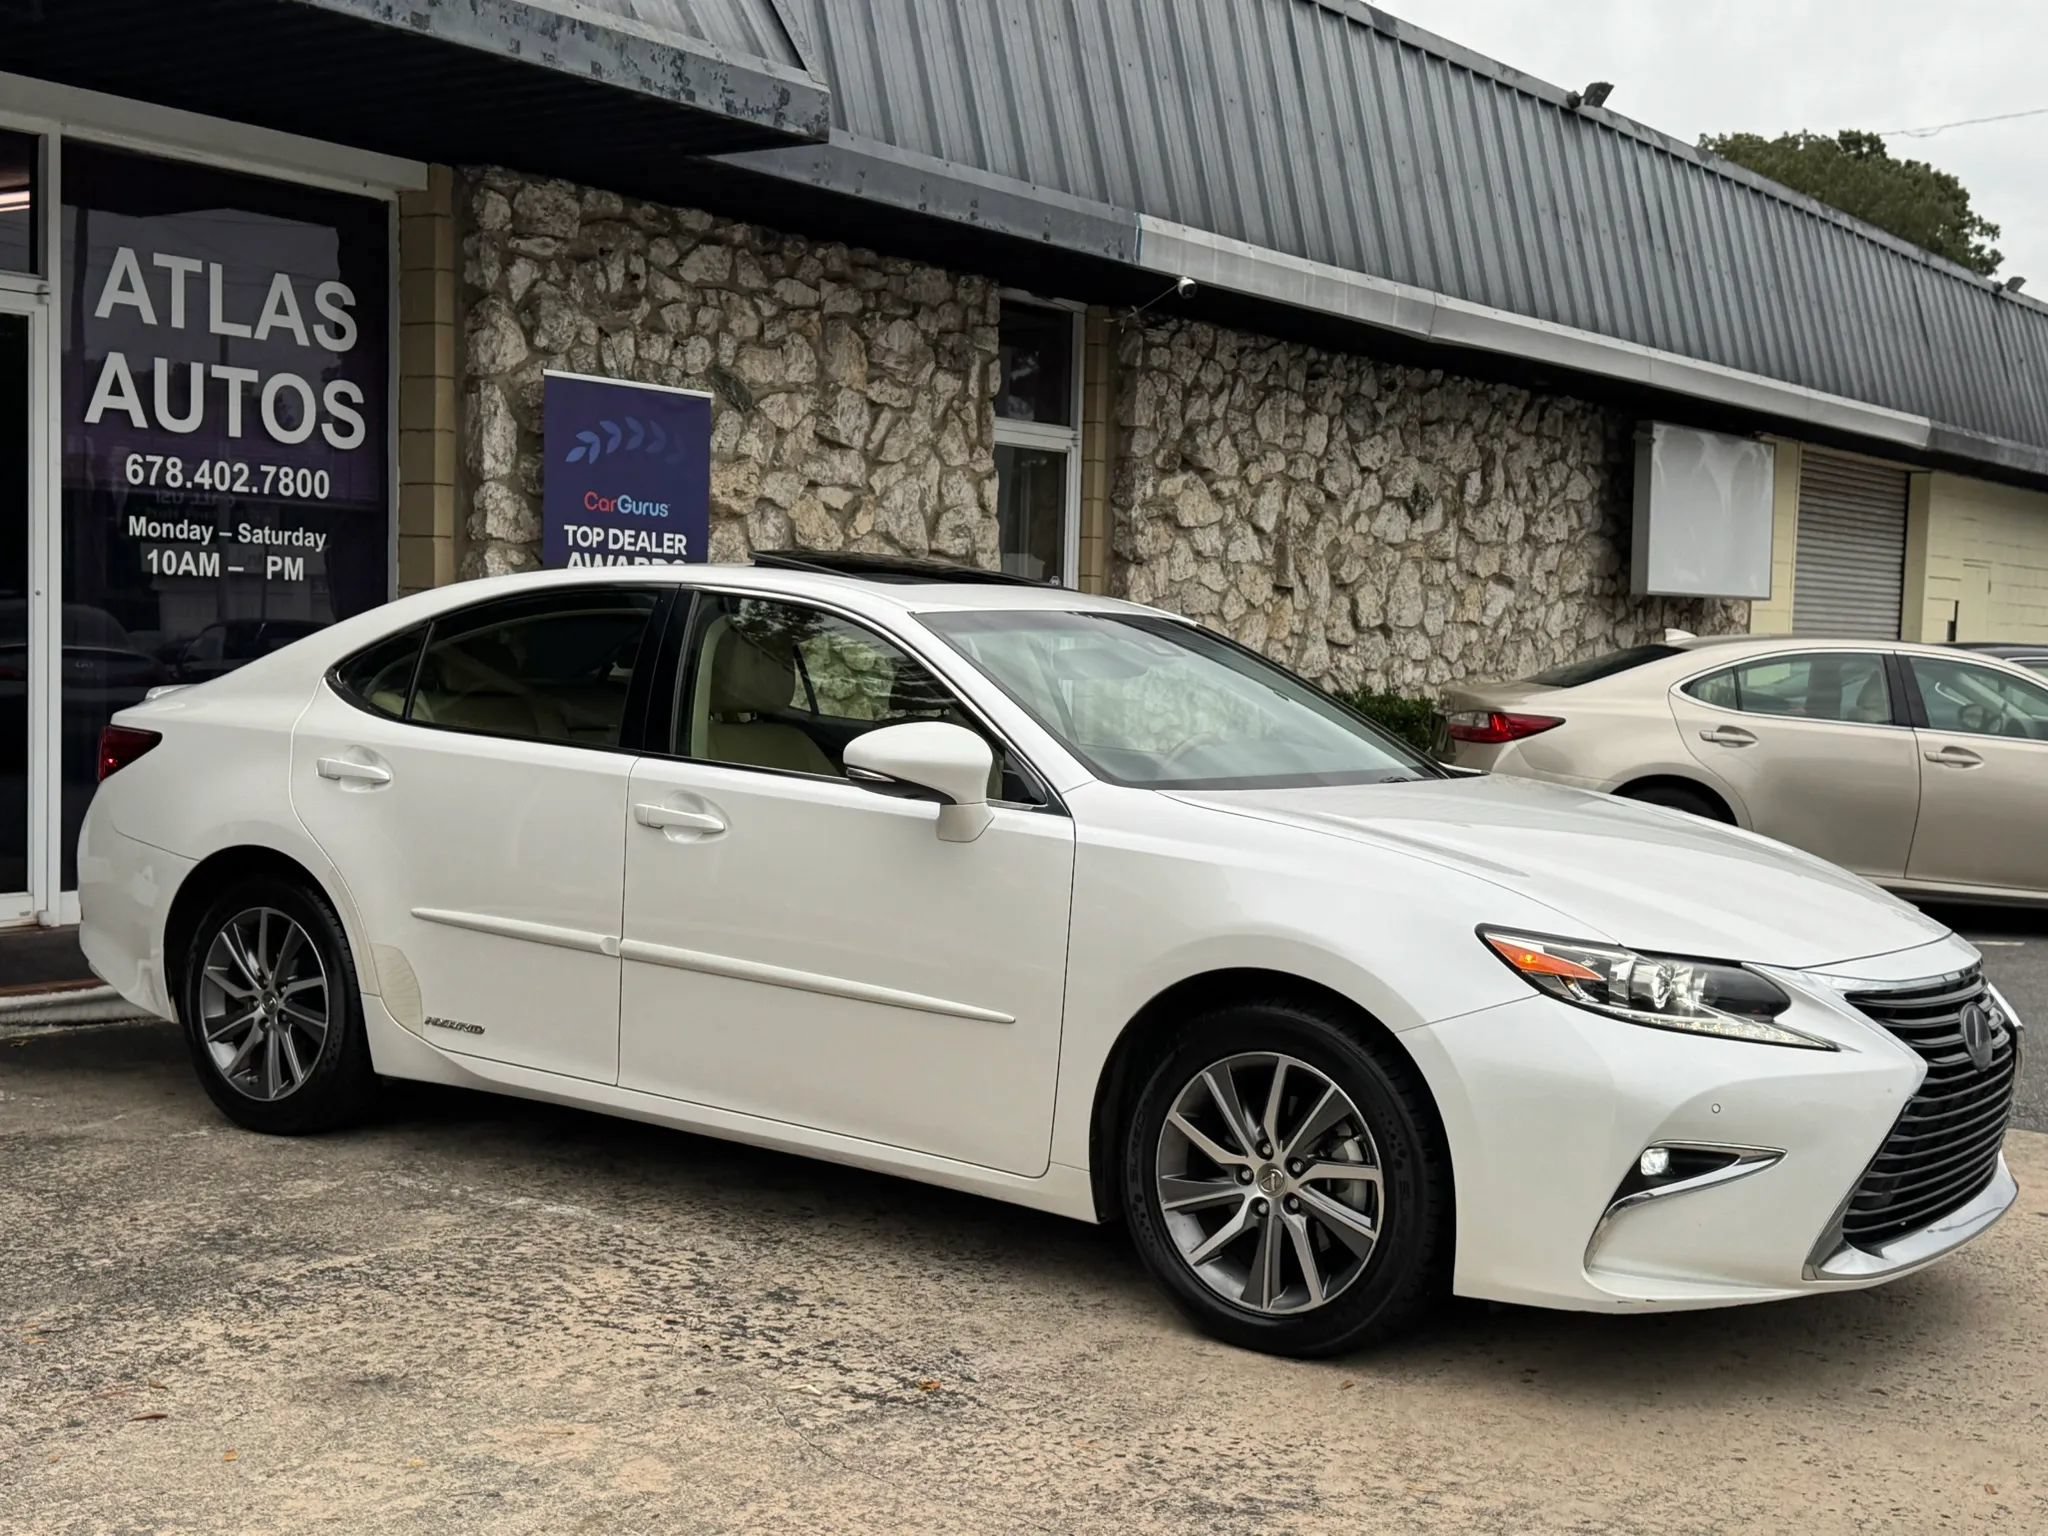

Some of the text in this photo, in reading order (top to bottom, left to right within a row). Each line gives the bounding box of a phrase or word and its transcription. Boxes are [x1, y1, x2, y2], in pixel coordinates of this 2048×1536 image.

[94, 246, 358, 353] ATLAS
[84, 351, 367, 450] AUTOS
[125, 453, 331, 500] 678.402.7800
[584, 491, 669, 517] CarGurus
[129, 515, 214, 547] Monday
[238, 523, 328, 553] Saturday
[564, 524, 687, 555] TOP DEALER
[147, 549, 220, 577] 10AM
[266, 555, 304, 581] PM
